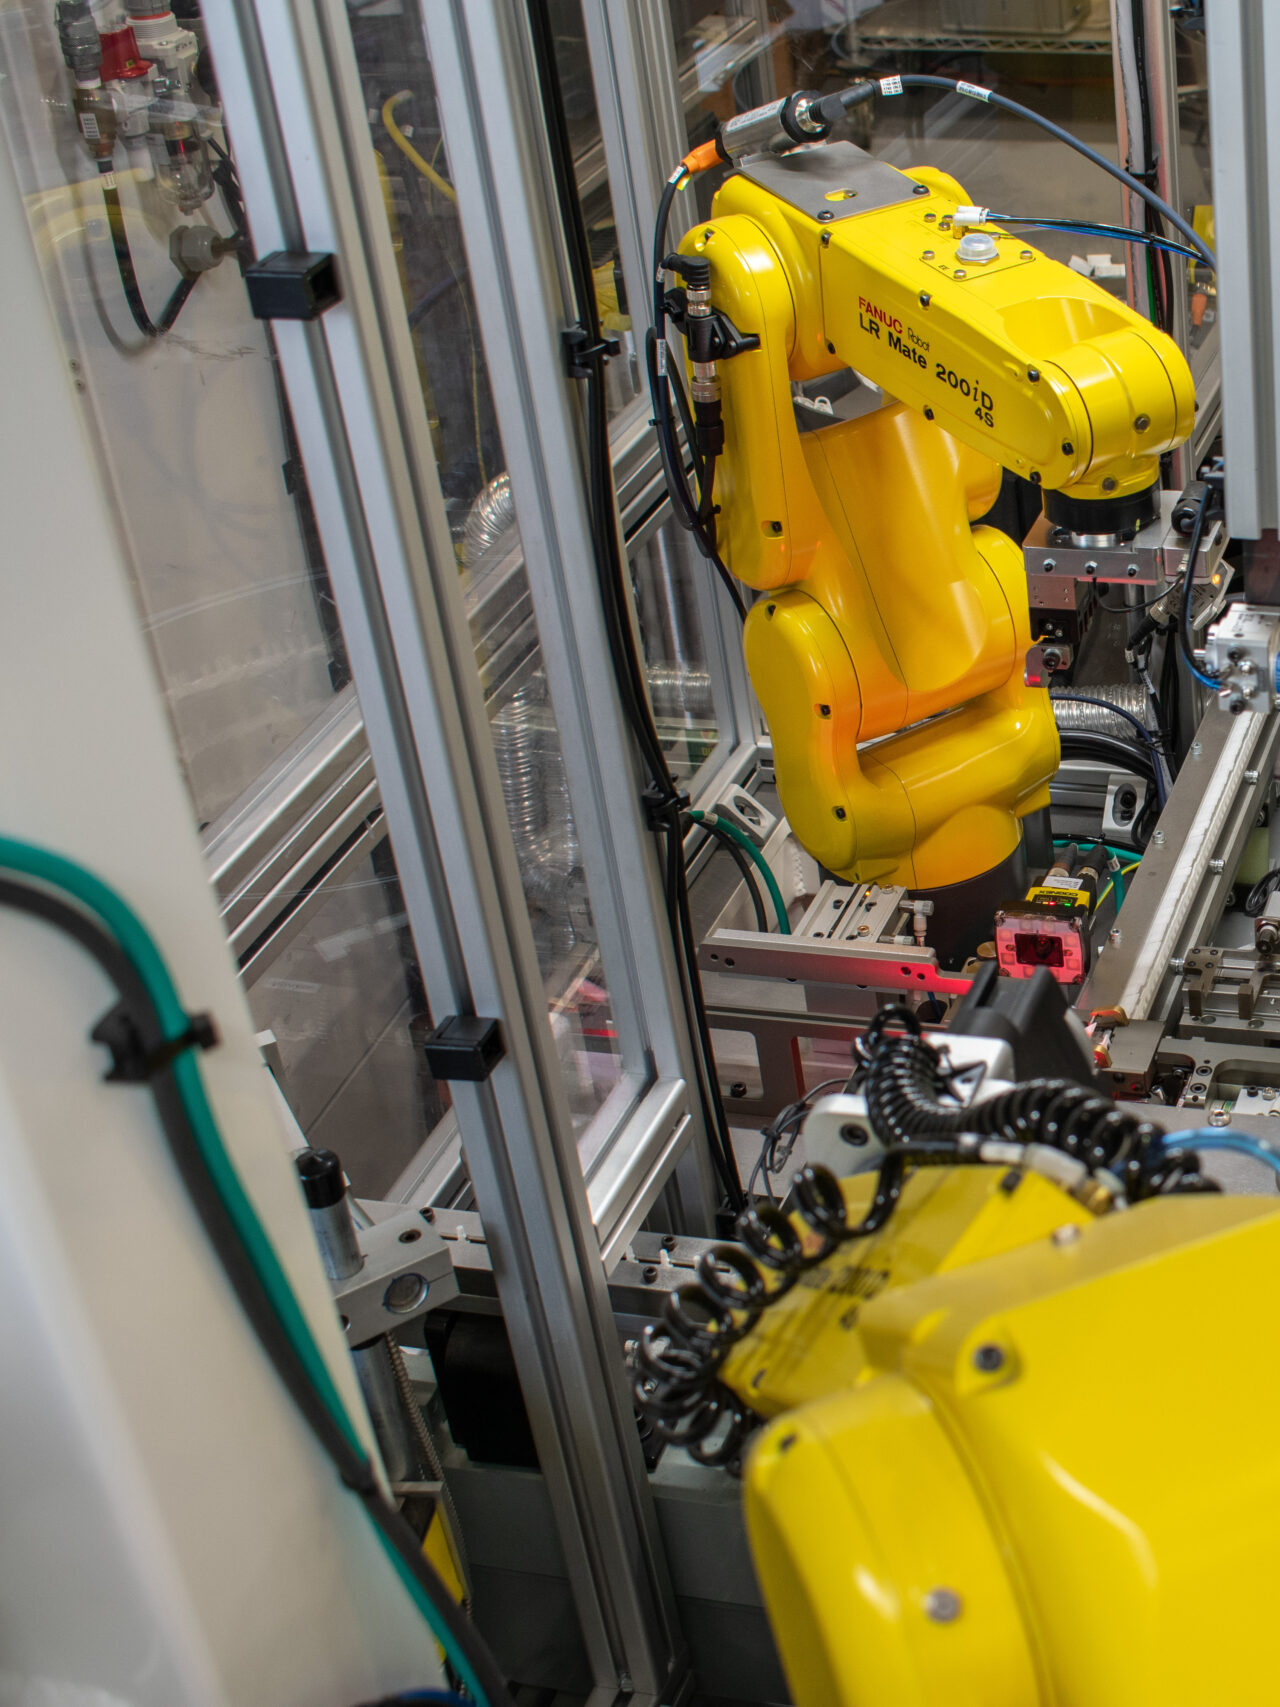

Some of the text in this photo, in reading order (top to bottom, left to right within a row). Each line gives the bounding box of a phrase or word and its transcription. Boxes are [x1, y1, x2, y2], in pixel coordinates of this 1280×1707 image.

[858, 296, 930, 352] FANUC Robot
[859, 312, 881, 339] LR
[888, 331, 928, 369] Mate
[974, 407, 994, 428] 4S
